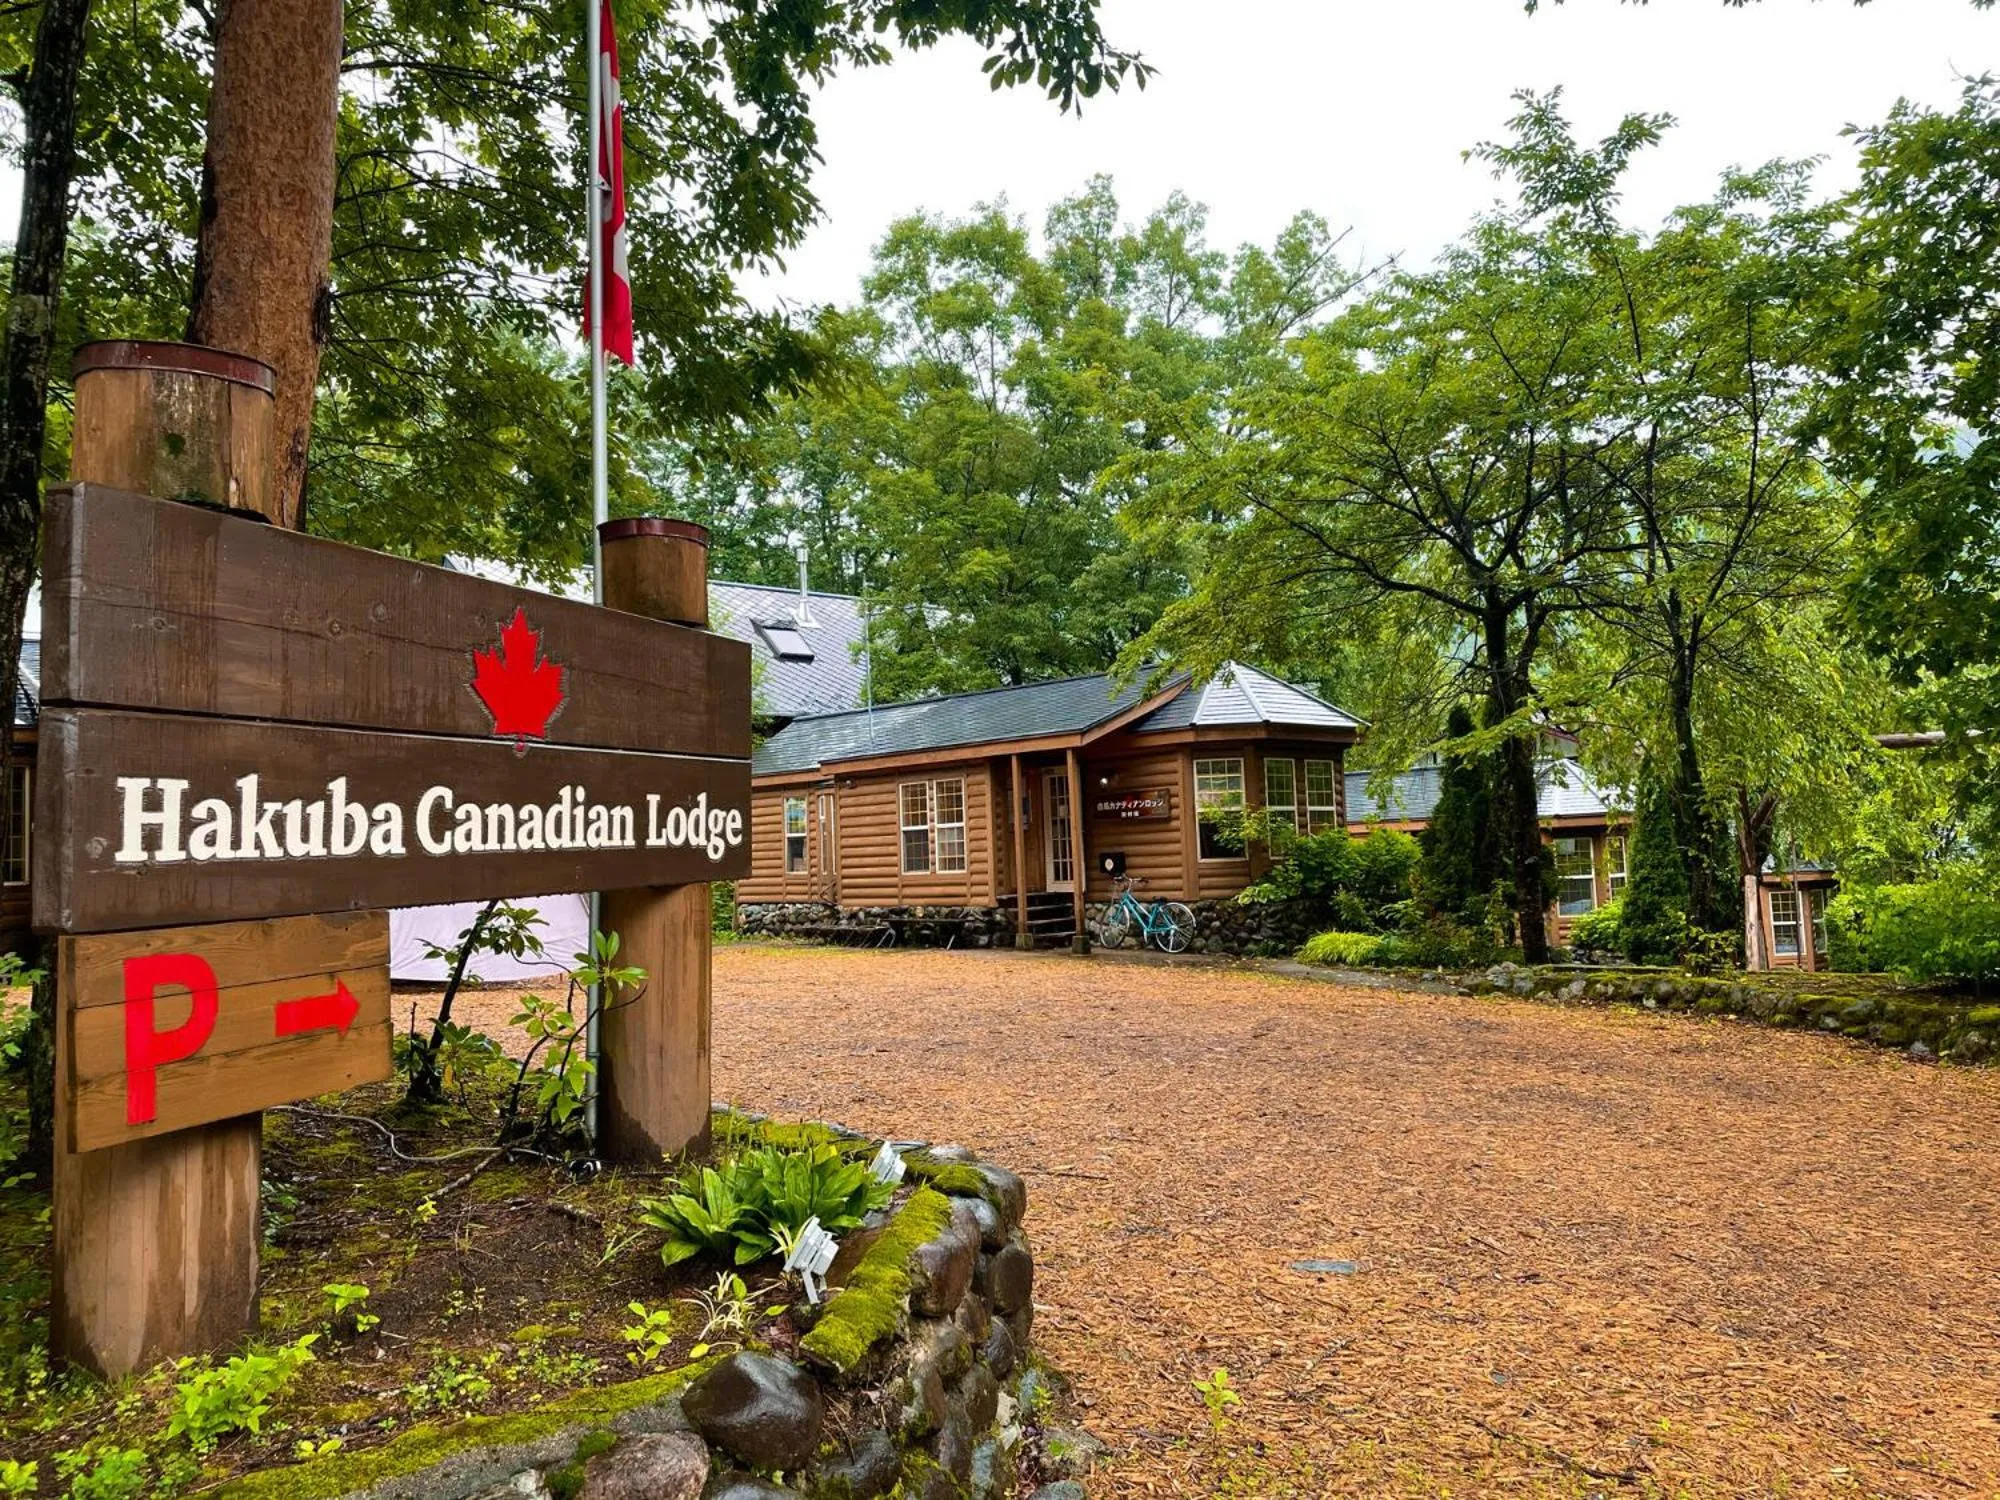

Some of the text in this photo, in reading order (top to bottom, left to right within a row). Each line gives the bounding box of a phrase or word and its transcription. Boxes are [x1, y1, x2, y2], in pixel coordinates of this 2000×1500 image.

[114, 773, 743, 863] Hakuba Canadian Lodge
[123, 953, 219, 1126] P
